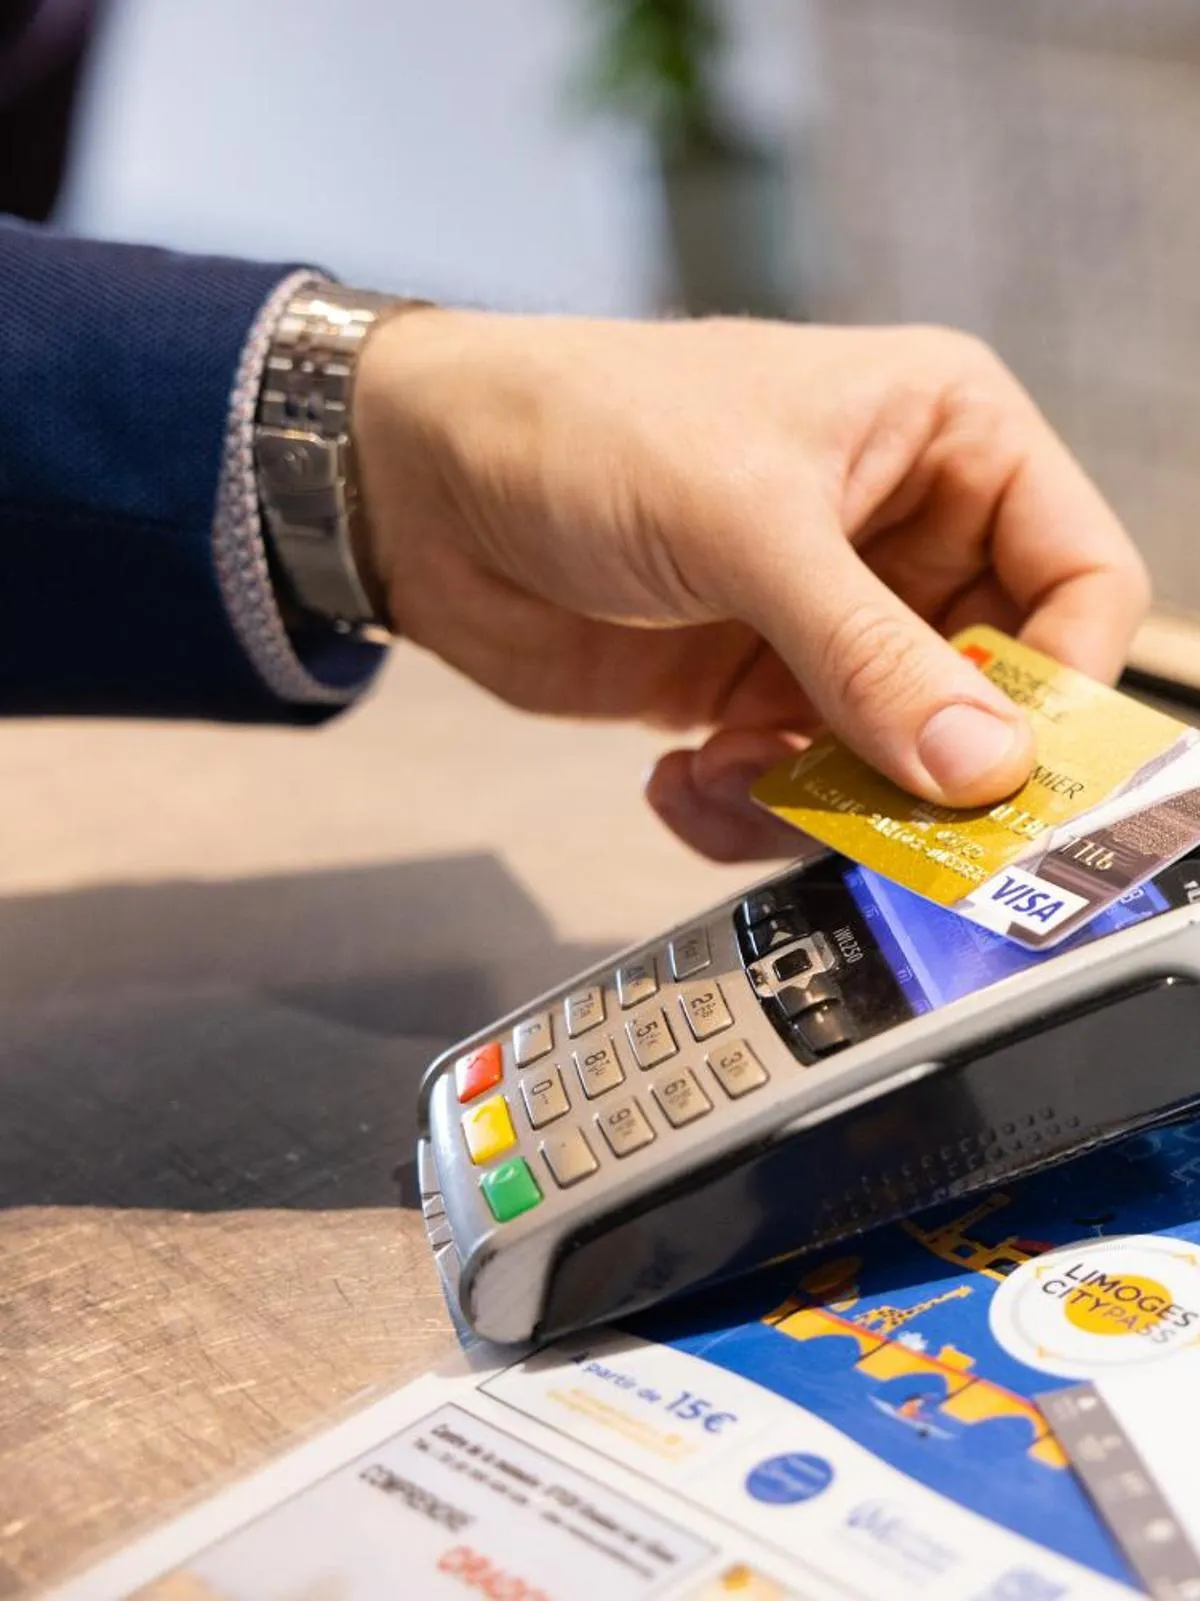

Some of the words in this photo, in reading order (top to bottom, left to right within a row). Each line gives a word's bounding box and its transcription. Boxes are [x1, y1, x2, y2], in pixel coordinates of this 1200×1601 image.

[1032, 765, 1084, 799] MIER
[992, 876, 1064, 922] VISA
[691, 992, 713, 1009] 2
[636, 1021, 658, 1038] 5
[608, 1108, 630, 1125] 9
[1042, 1279, 1177, 1344] CITYPASS
[1064, 1263, 1200, 1328] LIMOGES
[665, 1391, 738, 1433] 15€
